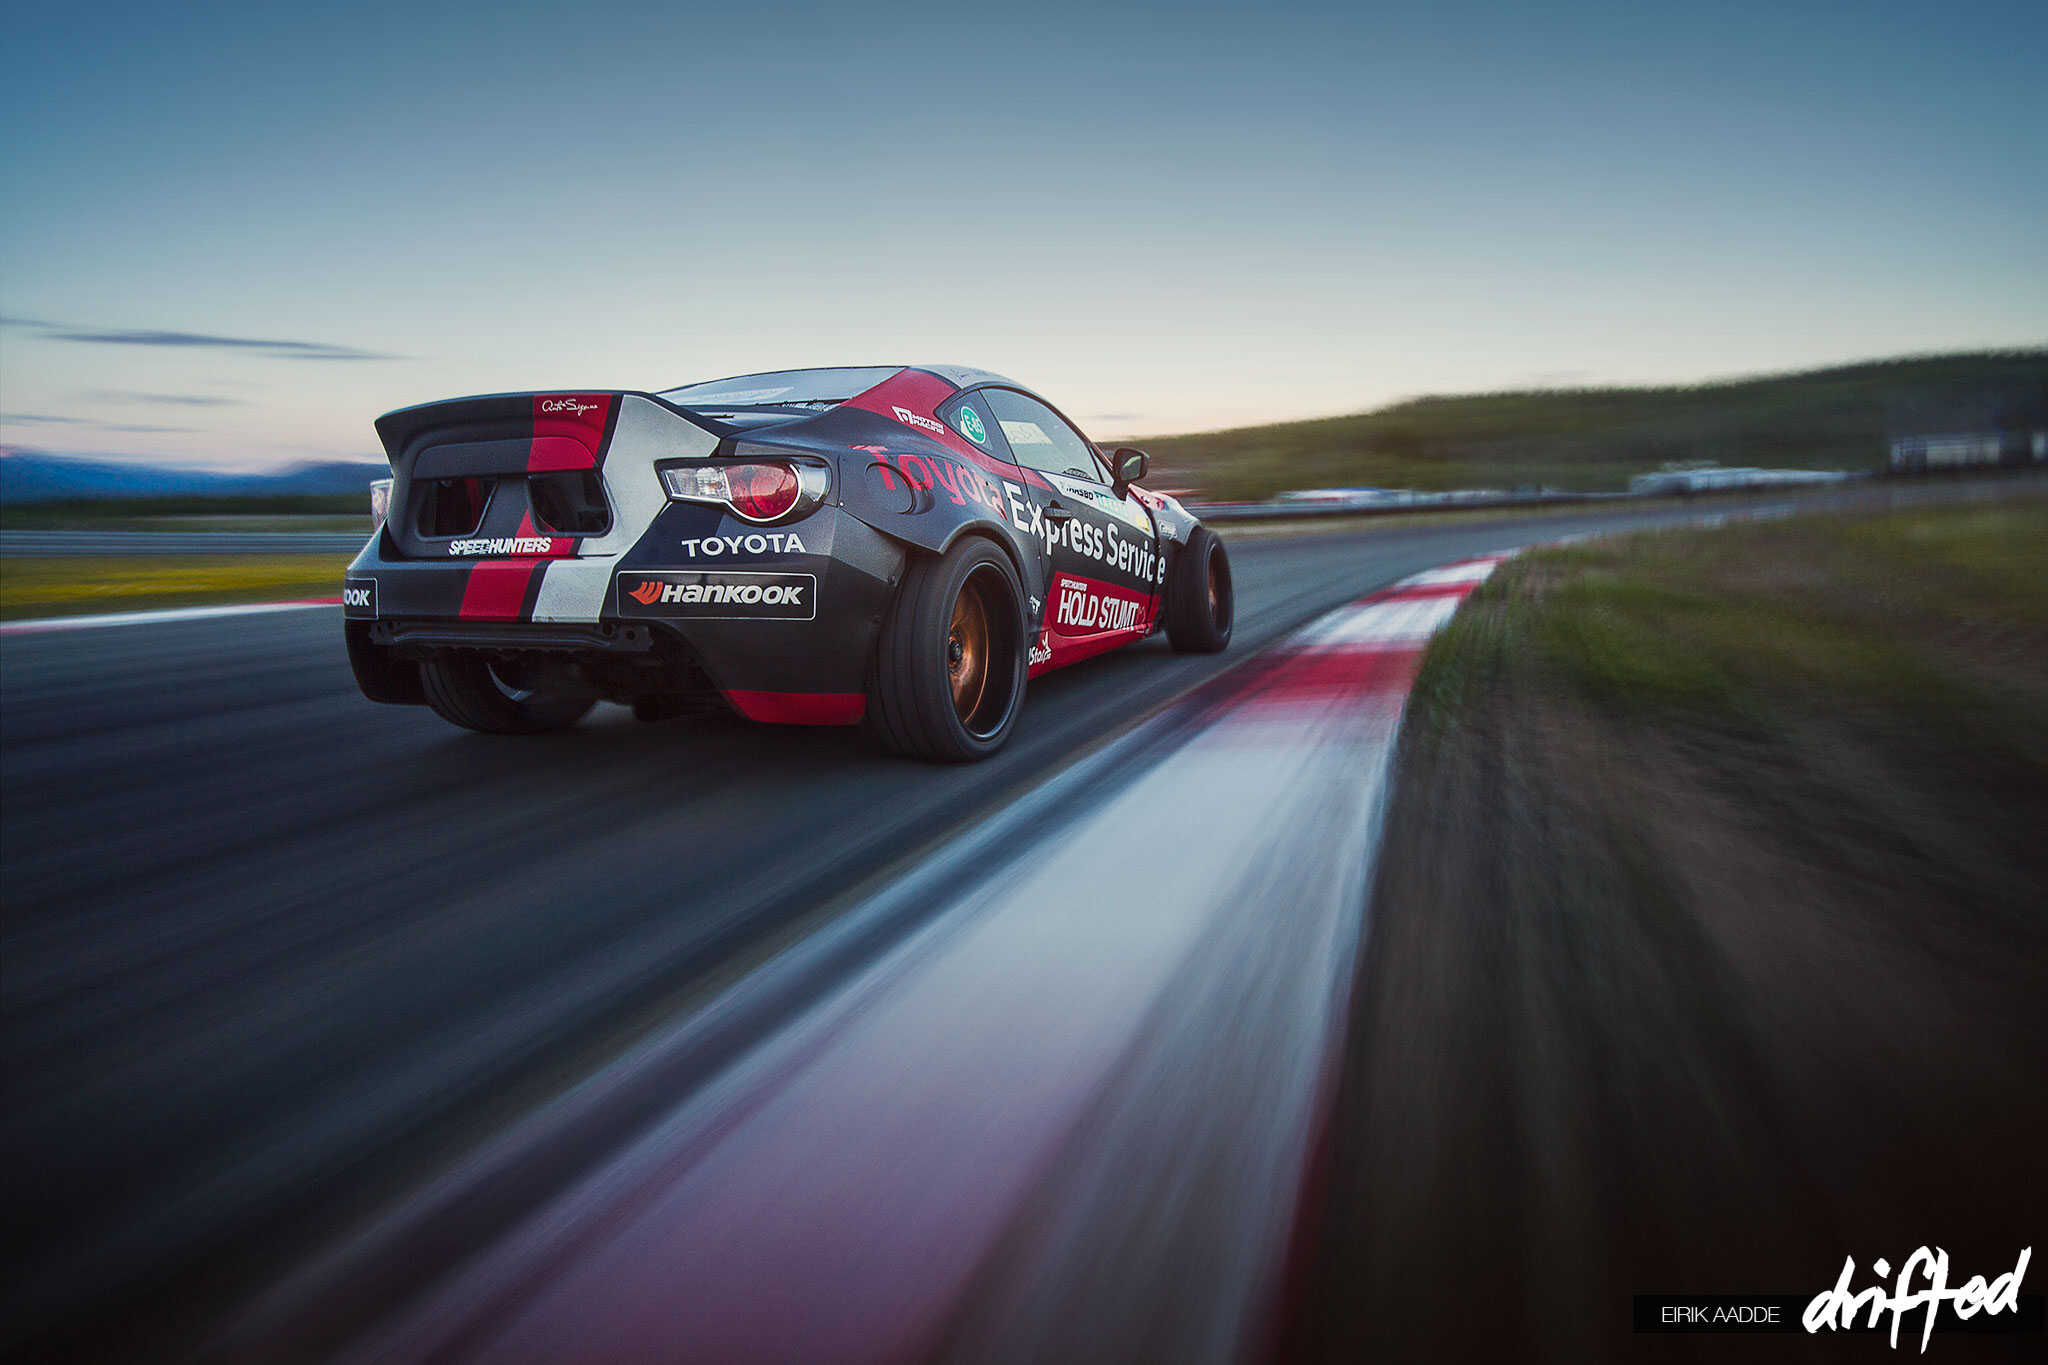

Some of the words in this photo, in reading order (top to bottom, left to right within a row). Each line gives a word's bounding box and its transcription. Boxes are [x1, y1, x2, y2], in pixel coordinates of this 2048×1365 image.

[681, 532, 807, 558] TOYOTA
[1002, 480, 1104, 561] Express
[1105, 522, 1167, 585] Service
[448, 536, 552, 556] SPEEDHUNTERS
[344, 588, 371, 607] OOK
[1056, 588, 1099, 627] HOLD
